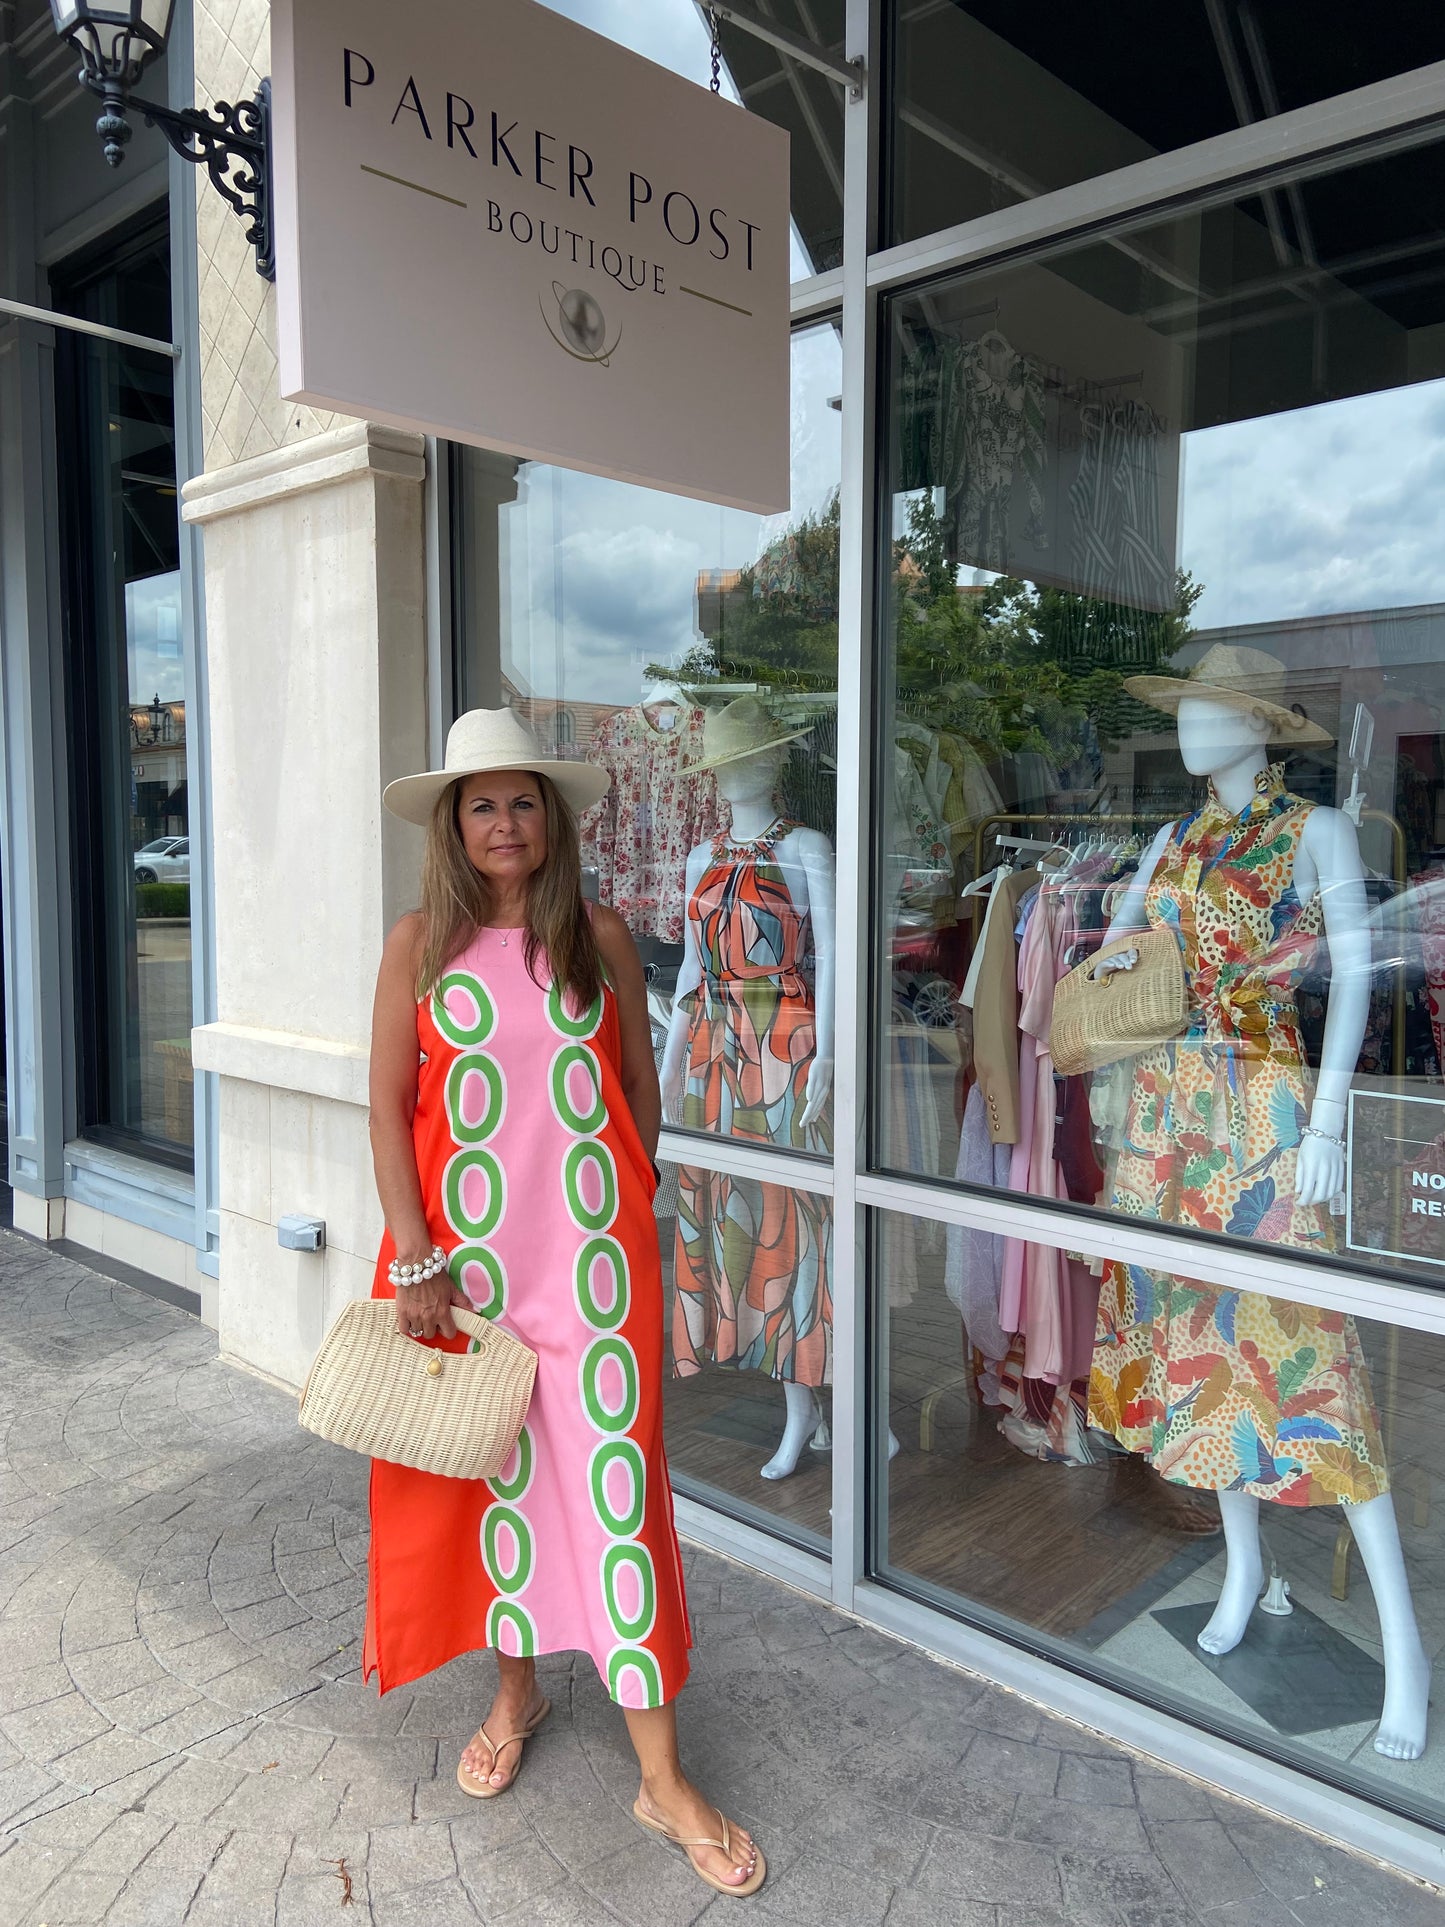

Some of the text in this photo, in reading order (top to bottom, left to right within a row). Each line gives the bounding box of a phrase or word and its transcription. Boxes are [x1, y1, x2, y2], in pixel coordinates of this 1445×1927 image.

[343, 47, 762, 271] PARKER POST
[486, 199, 666, 295] BOUTIQUE
[1411, 1197, 1445, 1217] RE
